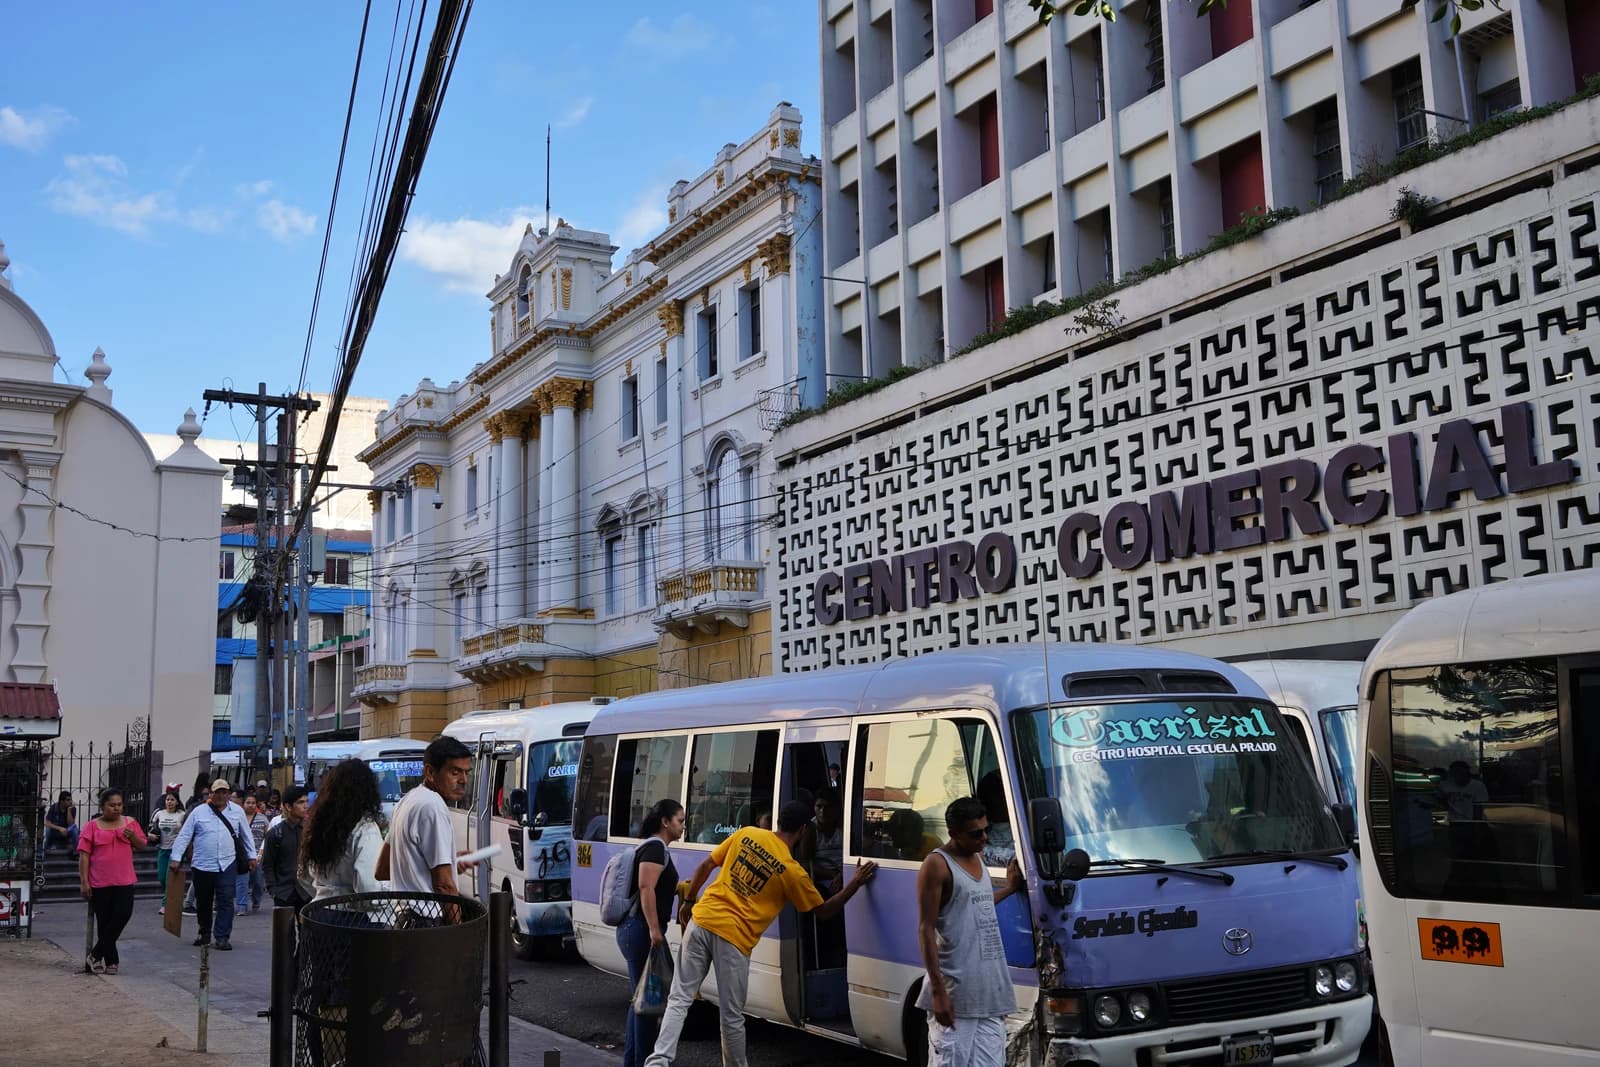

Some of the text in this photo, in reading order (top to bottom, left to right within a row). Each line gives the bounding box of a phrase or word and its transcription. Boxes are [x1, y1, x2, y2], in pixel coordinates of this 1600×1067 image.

[814, 401, 1577, 626] CENTRO COMERCIAL
[1051, 706, 1275, 749] Carrizal
[1072, 742, 1277, 764] CENTRO HOSPITAL ESCUELA PRADO
[741, 836, 787, 874] OLYMPUS
